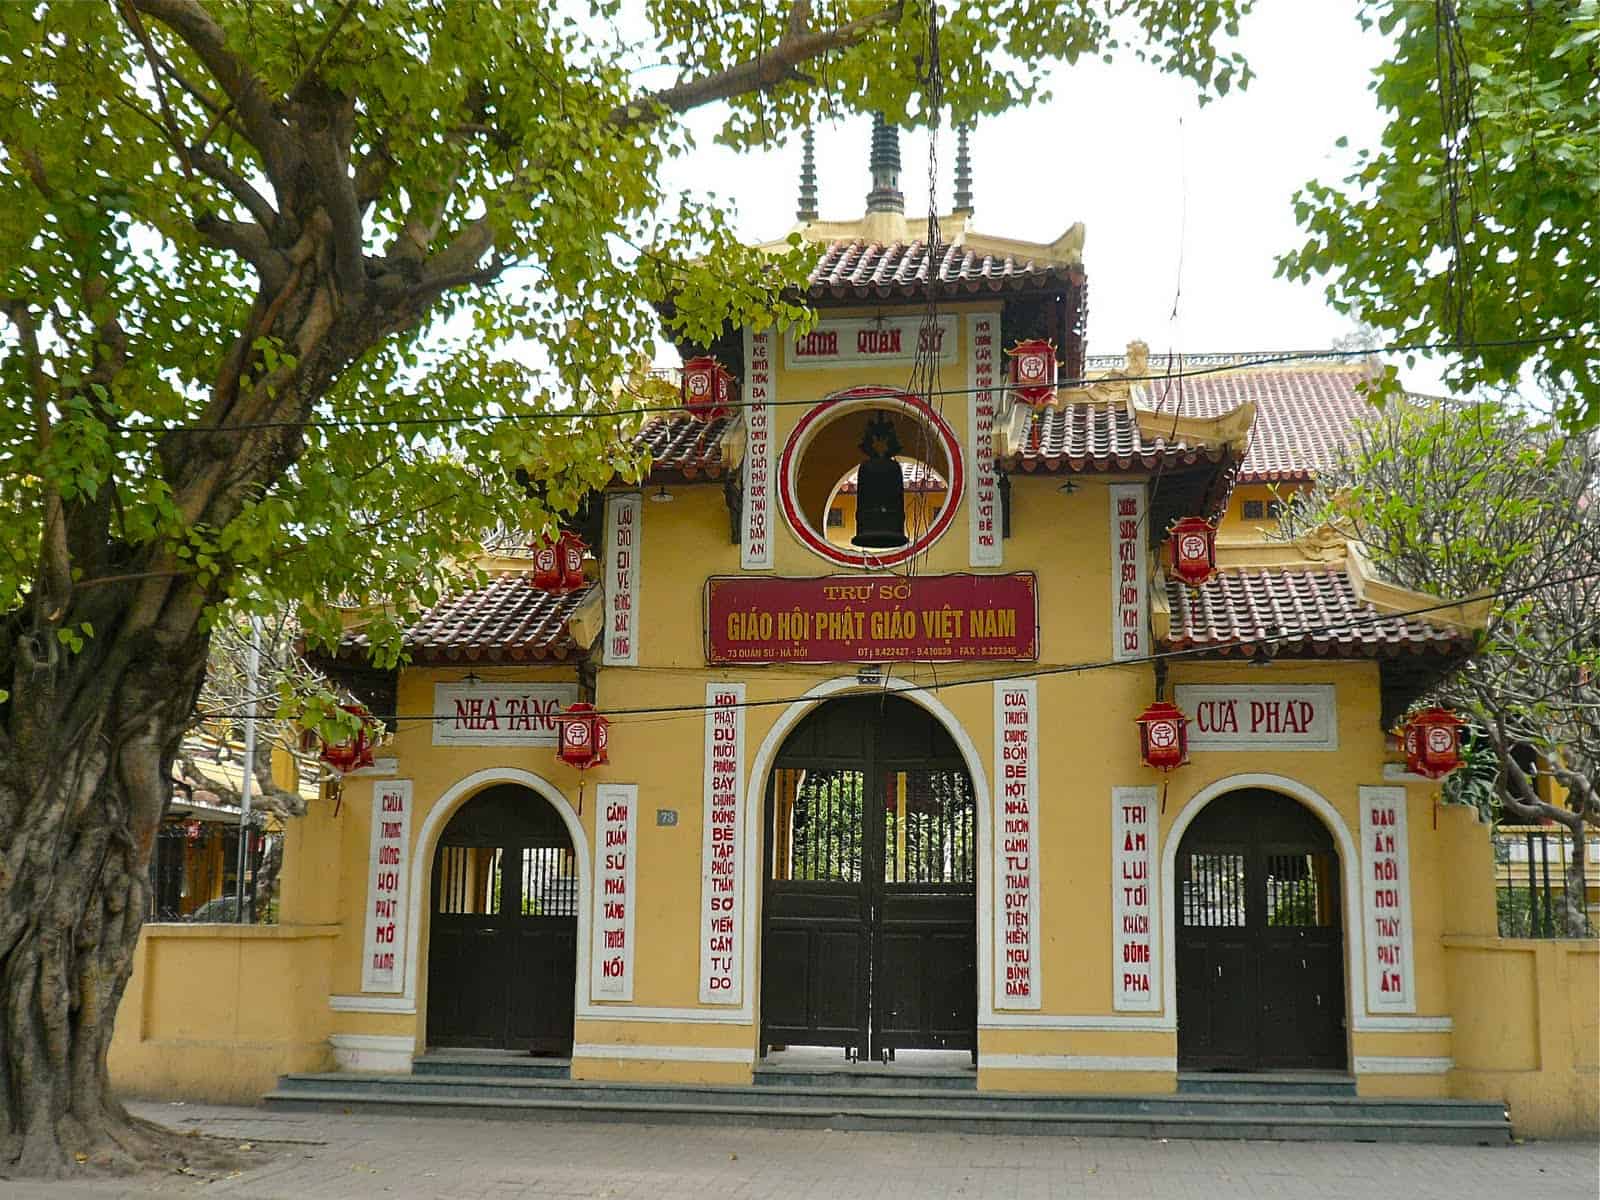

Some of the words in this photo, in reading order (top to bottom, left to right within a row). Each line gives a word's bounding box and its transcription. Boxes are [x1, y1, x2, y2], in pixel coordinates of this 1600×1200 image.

[750, 543, 764, 555] AN
[727, 606, 772, 641] GIÁO
[778, 607, 808, 643] HỘI
[816, 607, 864, 645] PHẬT
[871, 604, 917, 641] GIÁO
[922, 604, 964, 644] VIỆT
[970, 609, 1016, 639] NAM
[454, 696, 500, 730] NHÀ
[1249, 698, 1314, 732] PHÁP
[1122, 806, 1146, 824] TRI
[1006, 856, 1028, 870] TU
[1123, 861, 1147, 880] LUI
[377, 872, 399, 894] HỘI
[711, 897, 733, 911] SƠ
[1123, 913, 1149, 935] KHÁCH
[1006, 949, 1029, 963] NGU
[710, 976, 731, 989] DO
[1124, 973, 1149, 993] PHA
